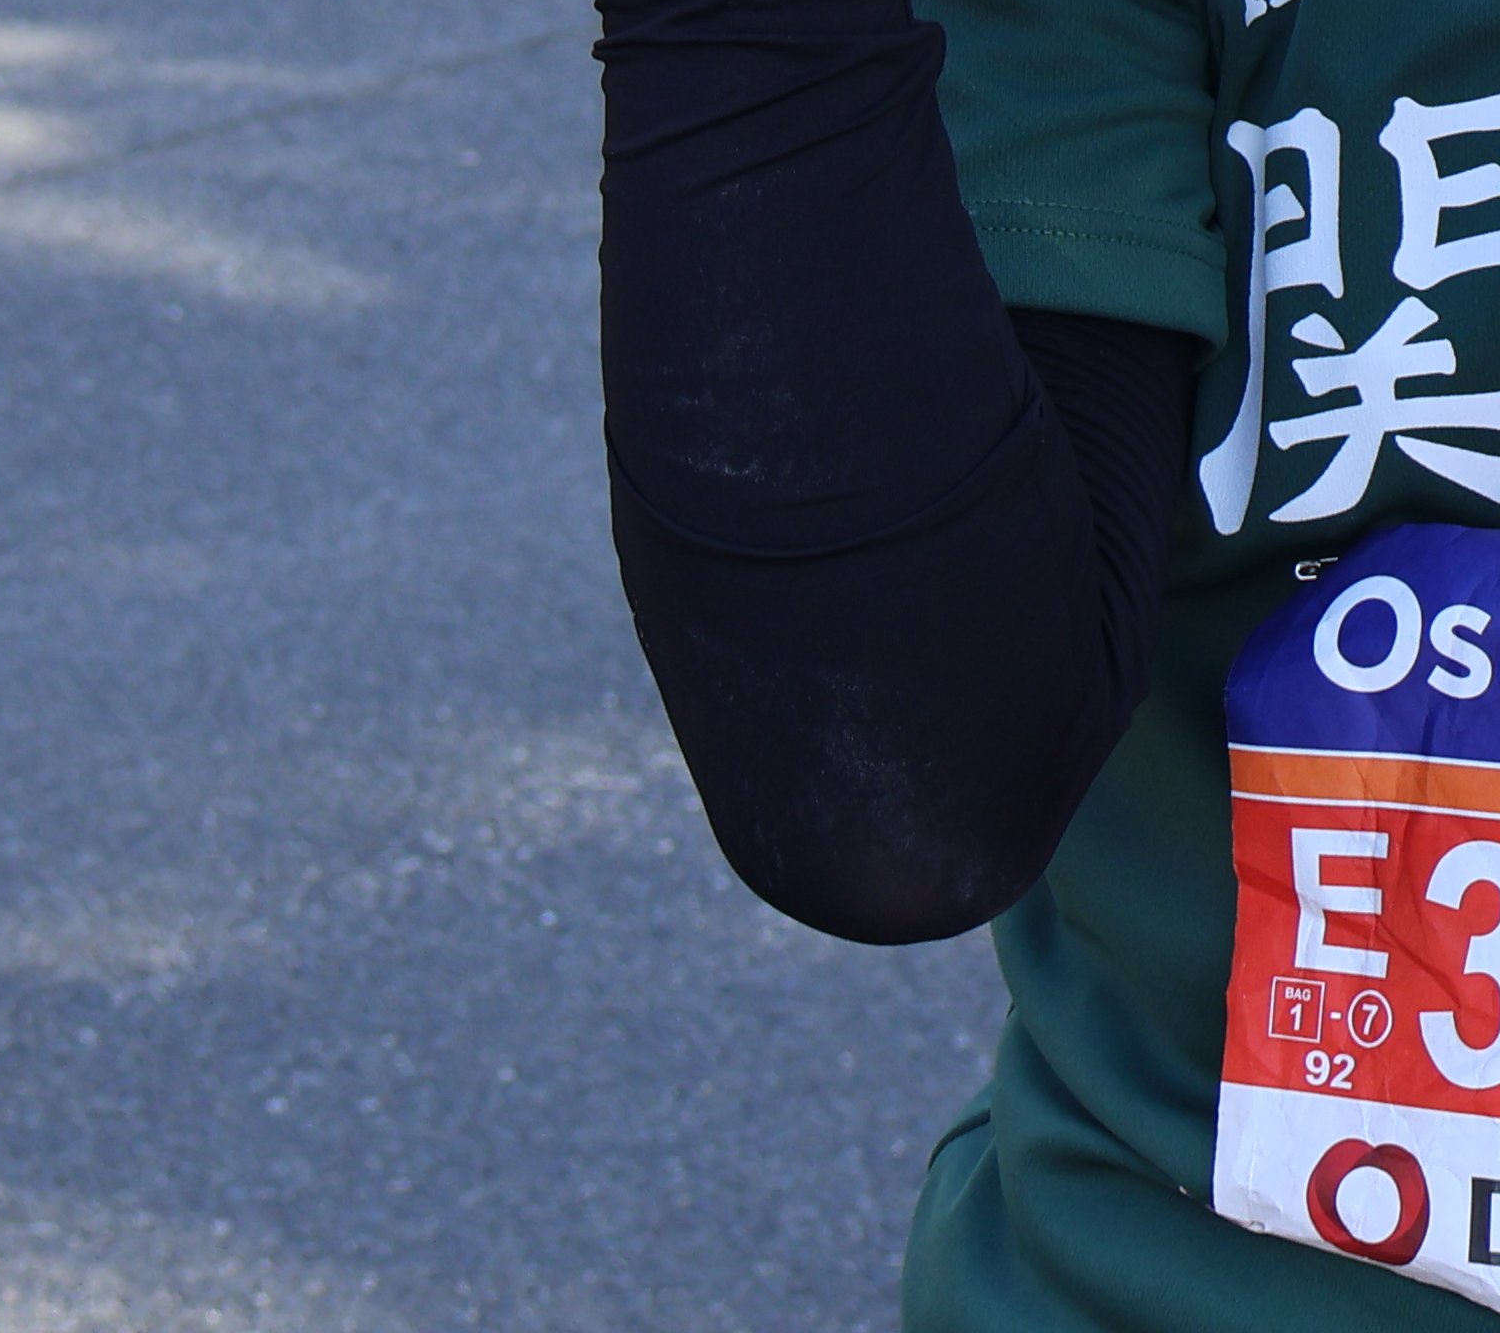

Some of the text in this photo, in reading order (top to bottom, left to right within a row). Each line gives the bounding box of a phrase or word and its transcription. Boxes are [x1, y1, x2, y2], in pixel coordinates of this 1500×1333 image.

[1291, 827, 1390, 979] E
[1284, 986, 1312, 1002] BAG
[1290, 1002, 1303, 1031] 1
[1360, 1002, 1379, 1035] 7
[1304, 1049, 1356, 1091] 92
